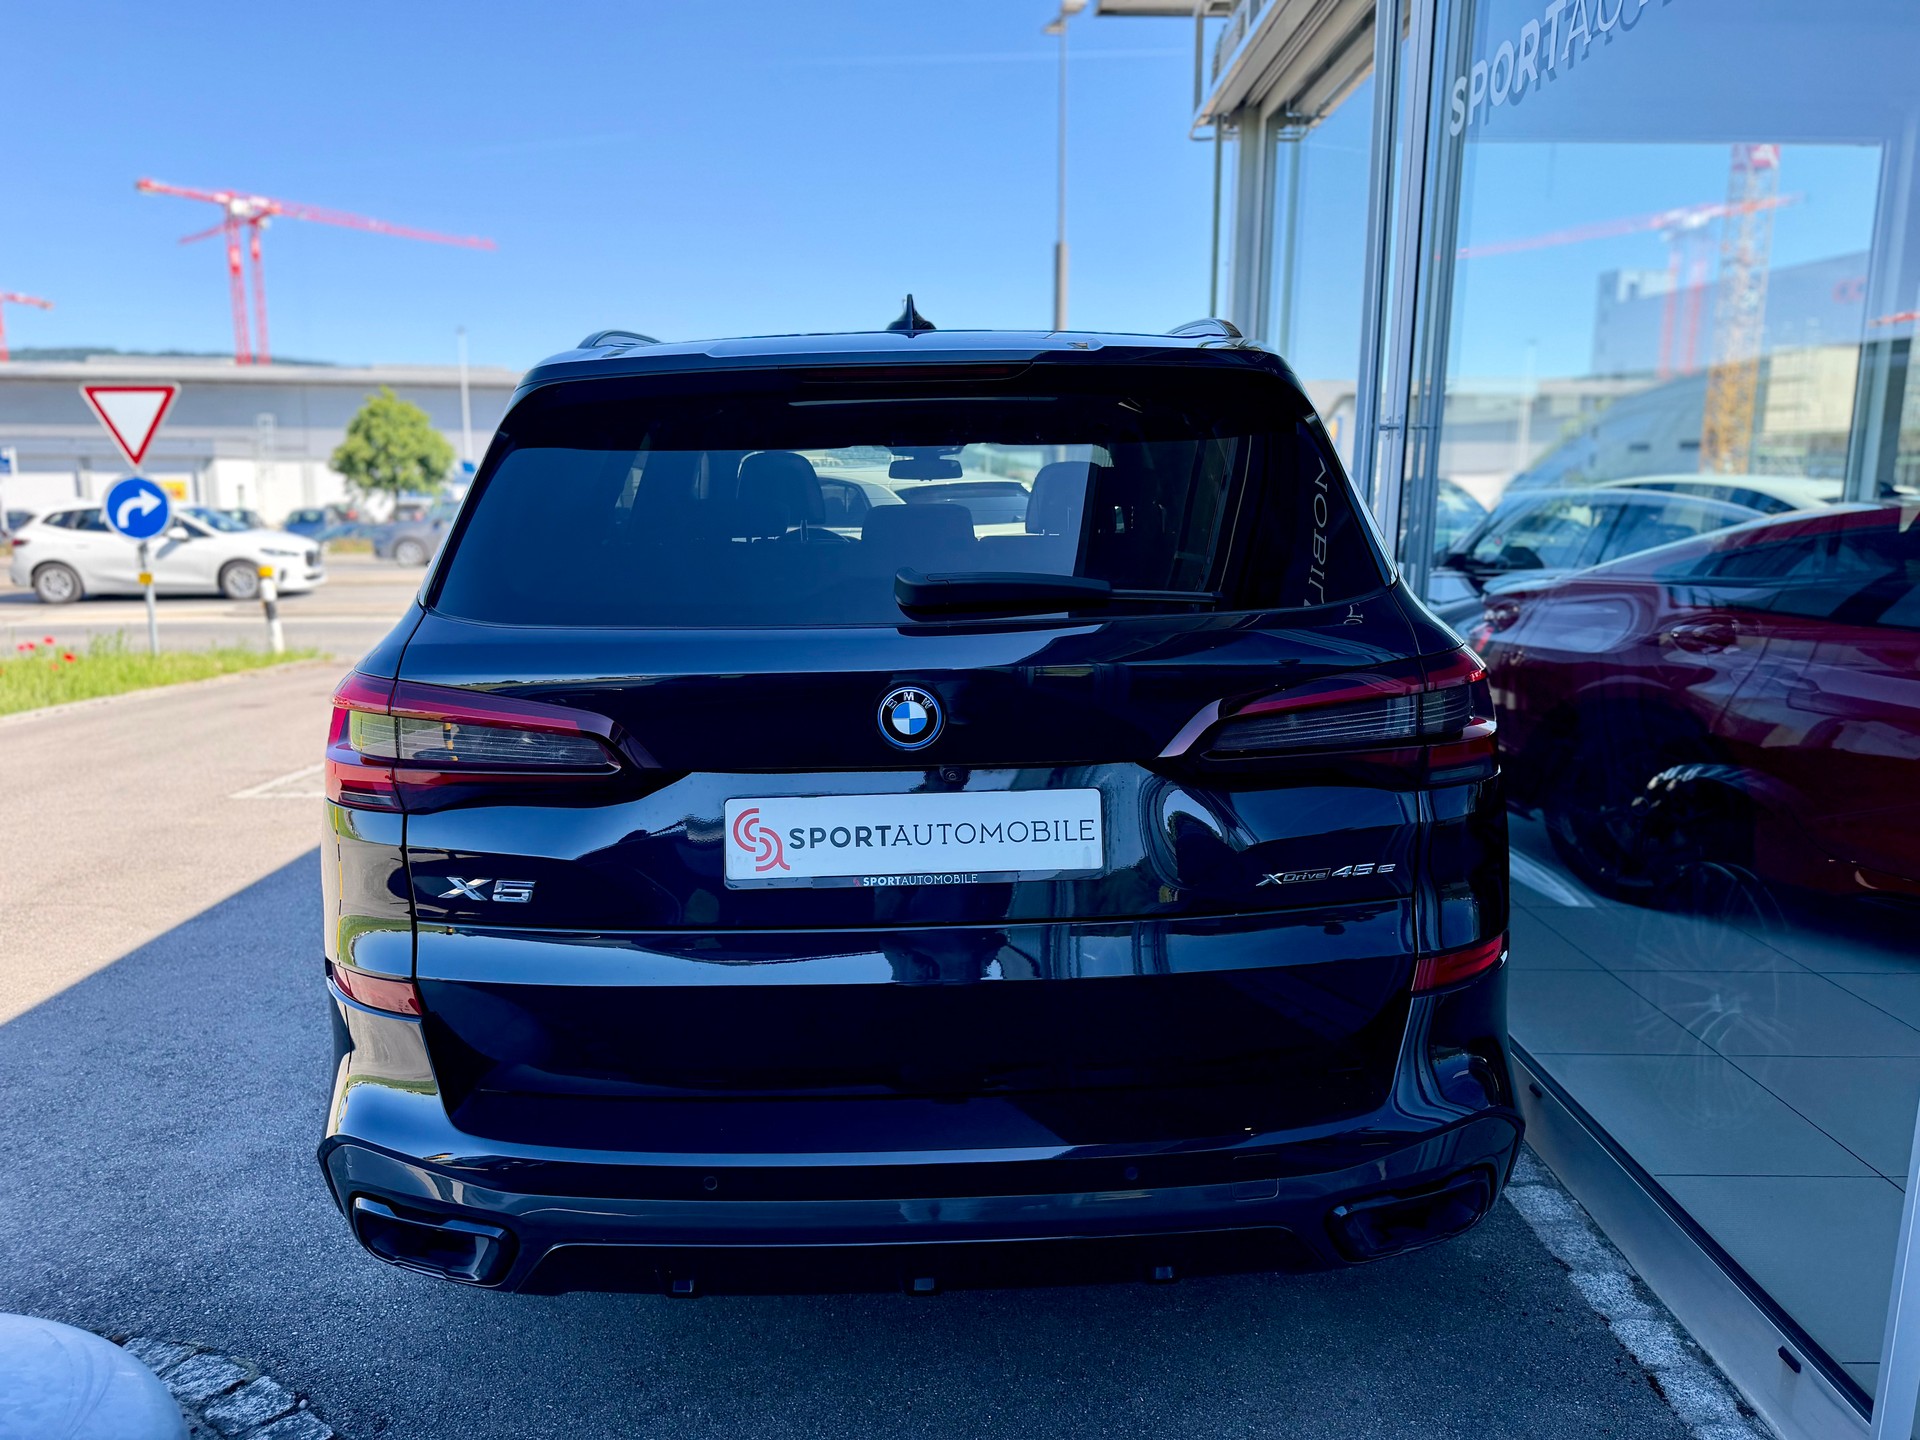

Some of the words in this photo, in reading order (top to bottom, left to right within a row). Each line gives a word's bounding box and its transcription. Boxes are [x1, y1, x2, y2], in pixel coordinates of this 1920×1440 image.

[1450, 0, 1649, 137] SPORTAU
[886, 691, 933, 710] BMW
[789, 819, 1095, 850] SPORTAUTOMOBILE
[437, 876, 537, 903] X5
[863, 873, 978, 887] SPORTAUTOMOBILE
